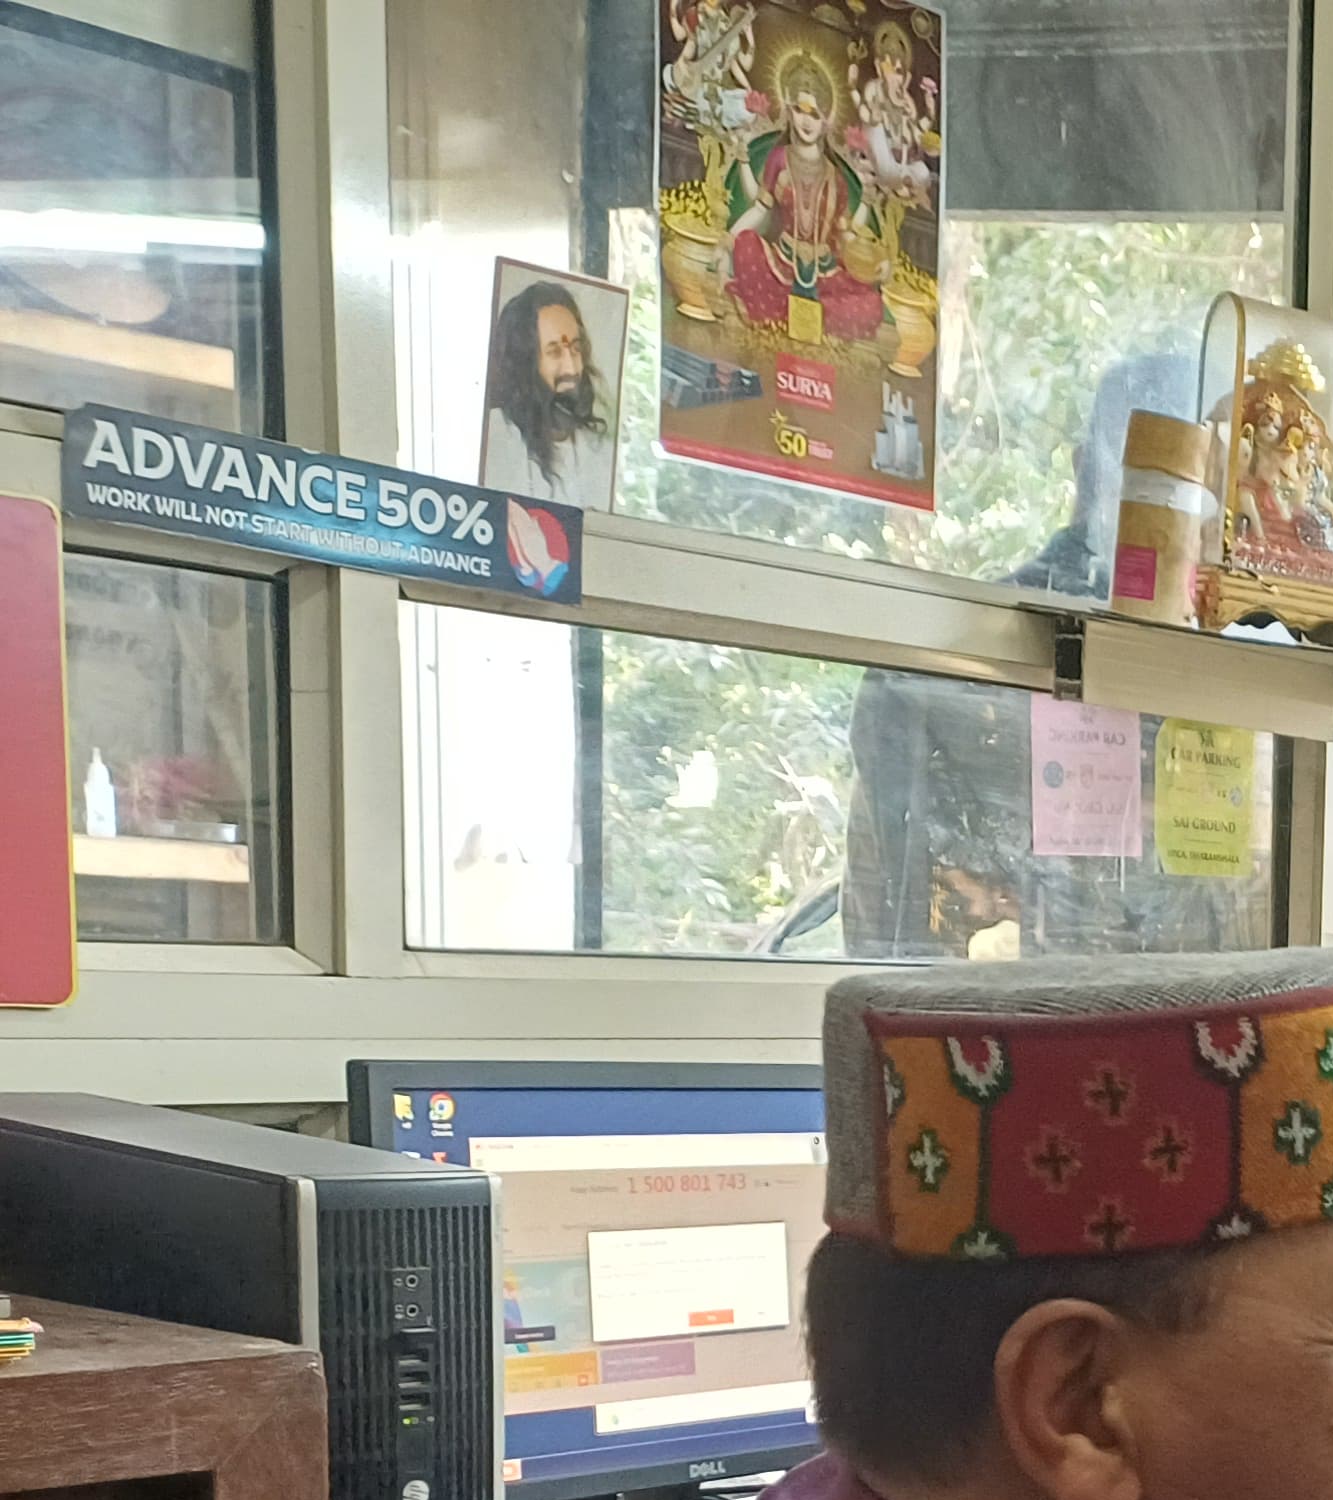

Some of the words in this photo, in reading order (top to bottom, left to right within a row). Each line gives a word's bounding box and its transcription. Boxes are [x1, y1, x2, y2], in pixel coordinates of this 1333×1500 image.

[777, 371, 832, 400] SURYA
[780, 430, 807, 457] 50
[82, 419, 367, 520] ADVANCE
[377, 479, 494, 546] 50%
[85, 482, 151, 514] WORK
[153, 495, 202, 522] WILL
[204, 504, 251, 530] NOT
[250, 514, 315, 547] START
[318, 531, 407, 561] WITHOUT
[408, 544, 492, 578] ADVANCE
[1191, 817, 1236, 834] GROUND
[644, 1176, 674, 1192] 500
[680, 1175, 711, 1191] 801
[717, 1174, 745, 1190] 743
[689, 1460, 727, 1478] DELL
